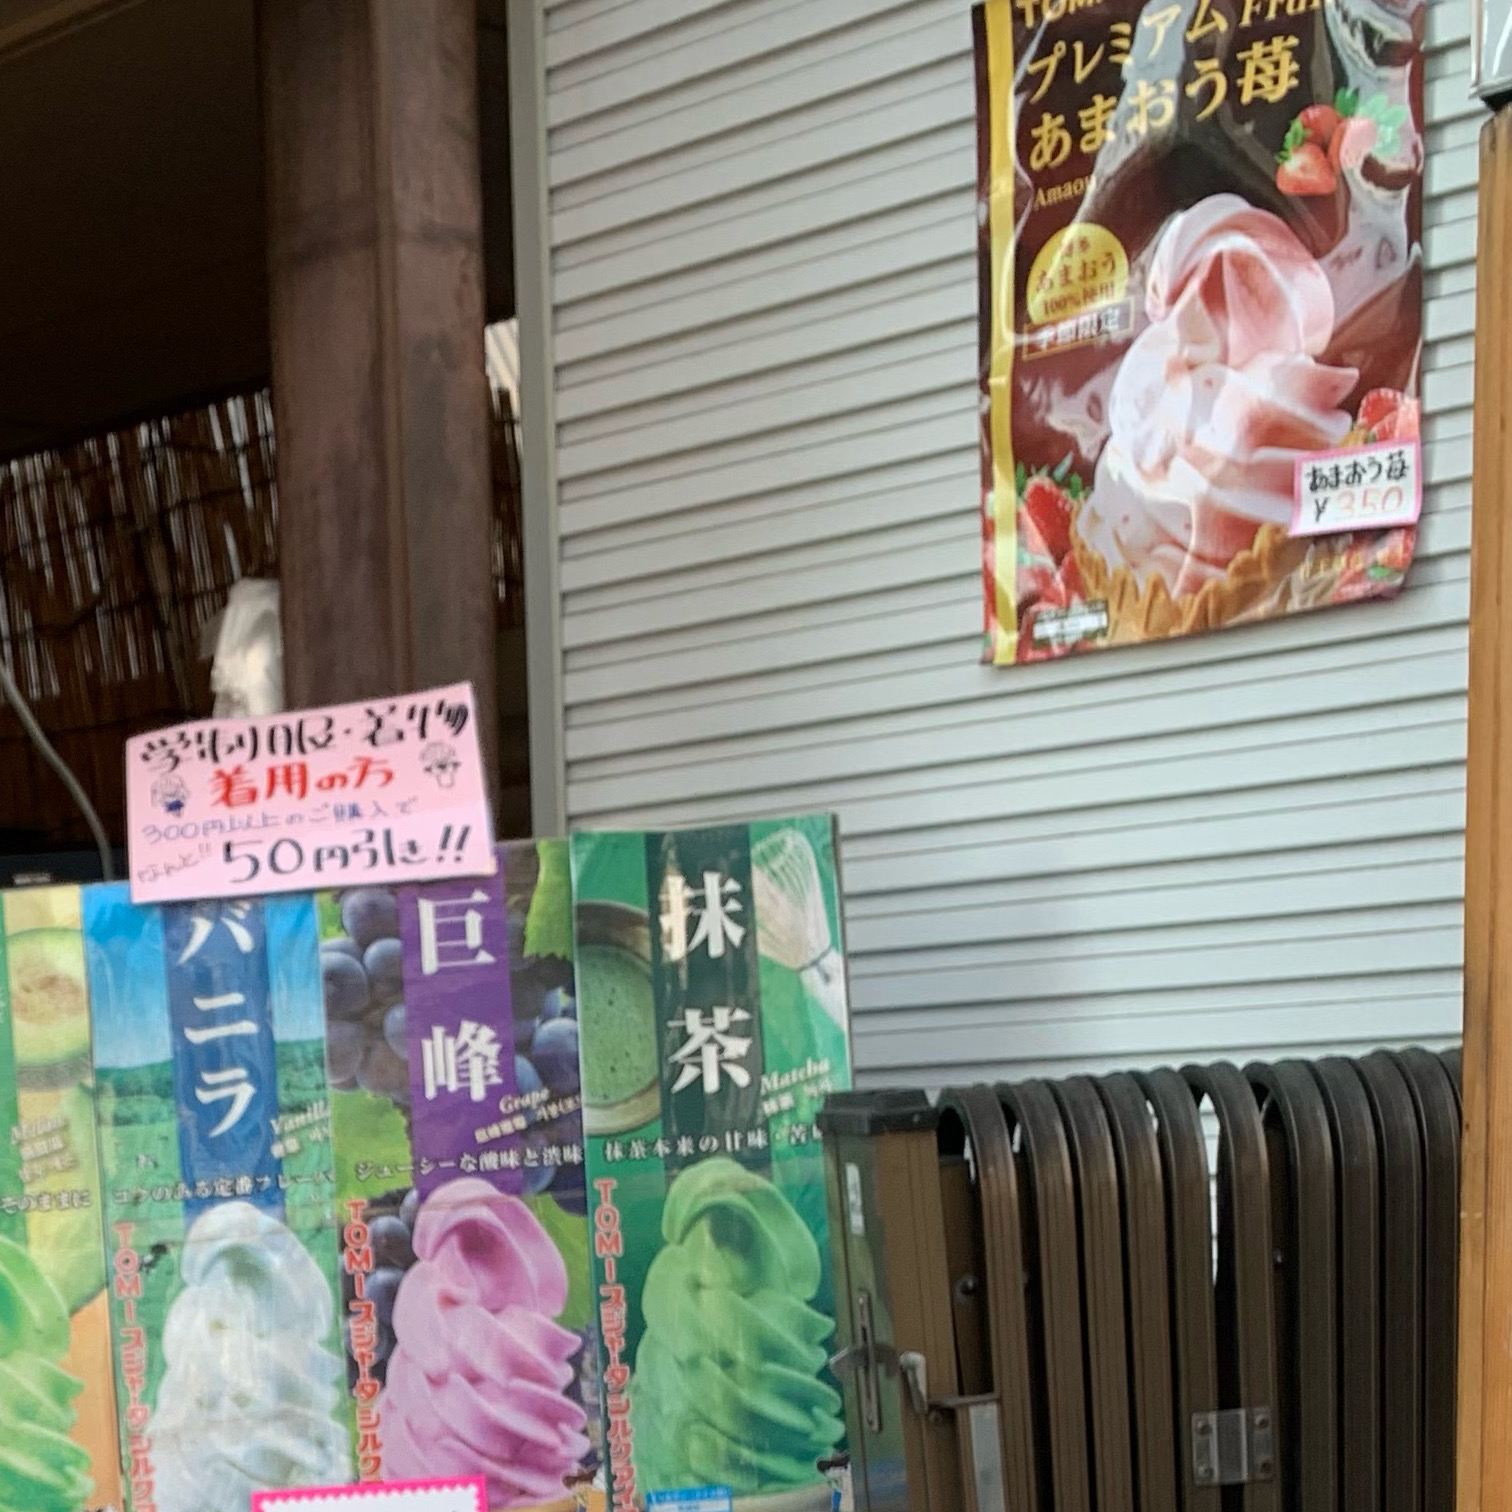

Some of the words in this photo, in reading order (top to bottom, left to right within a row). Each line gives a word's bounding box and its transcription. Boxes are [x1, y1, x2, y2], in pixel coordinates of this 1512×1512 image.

[1027, 0, 1230, 104] プレミアム
[1029, 35, 1300, 171] あまおう苺
[209, 757, 394, 807] 着用の方
[178, 901, 259, 1138] バニラ
[417, 888, 503, 1102] 巨峰
[659, 871, 753, 1094] 抹茶
